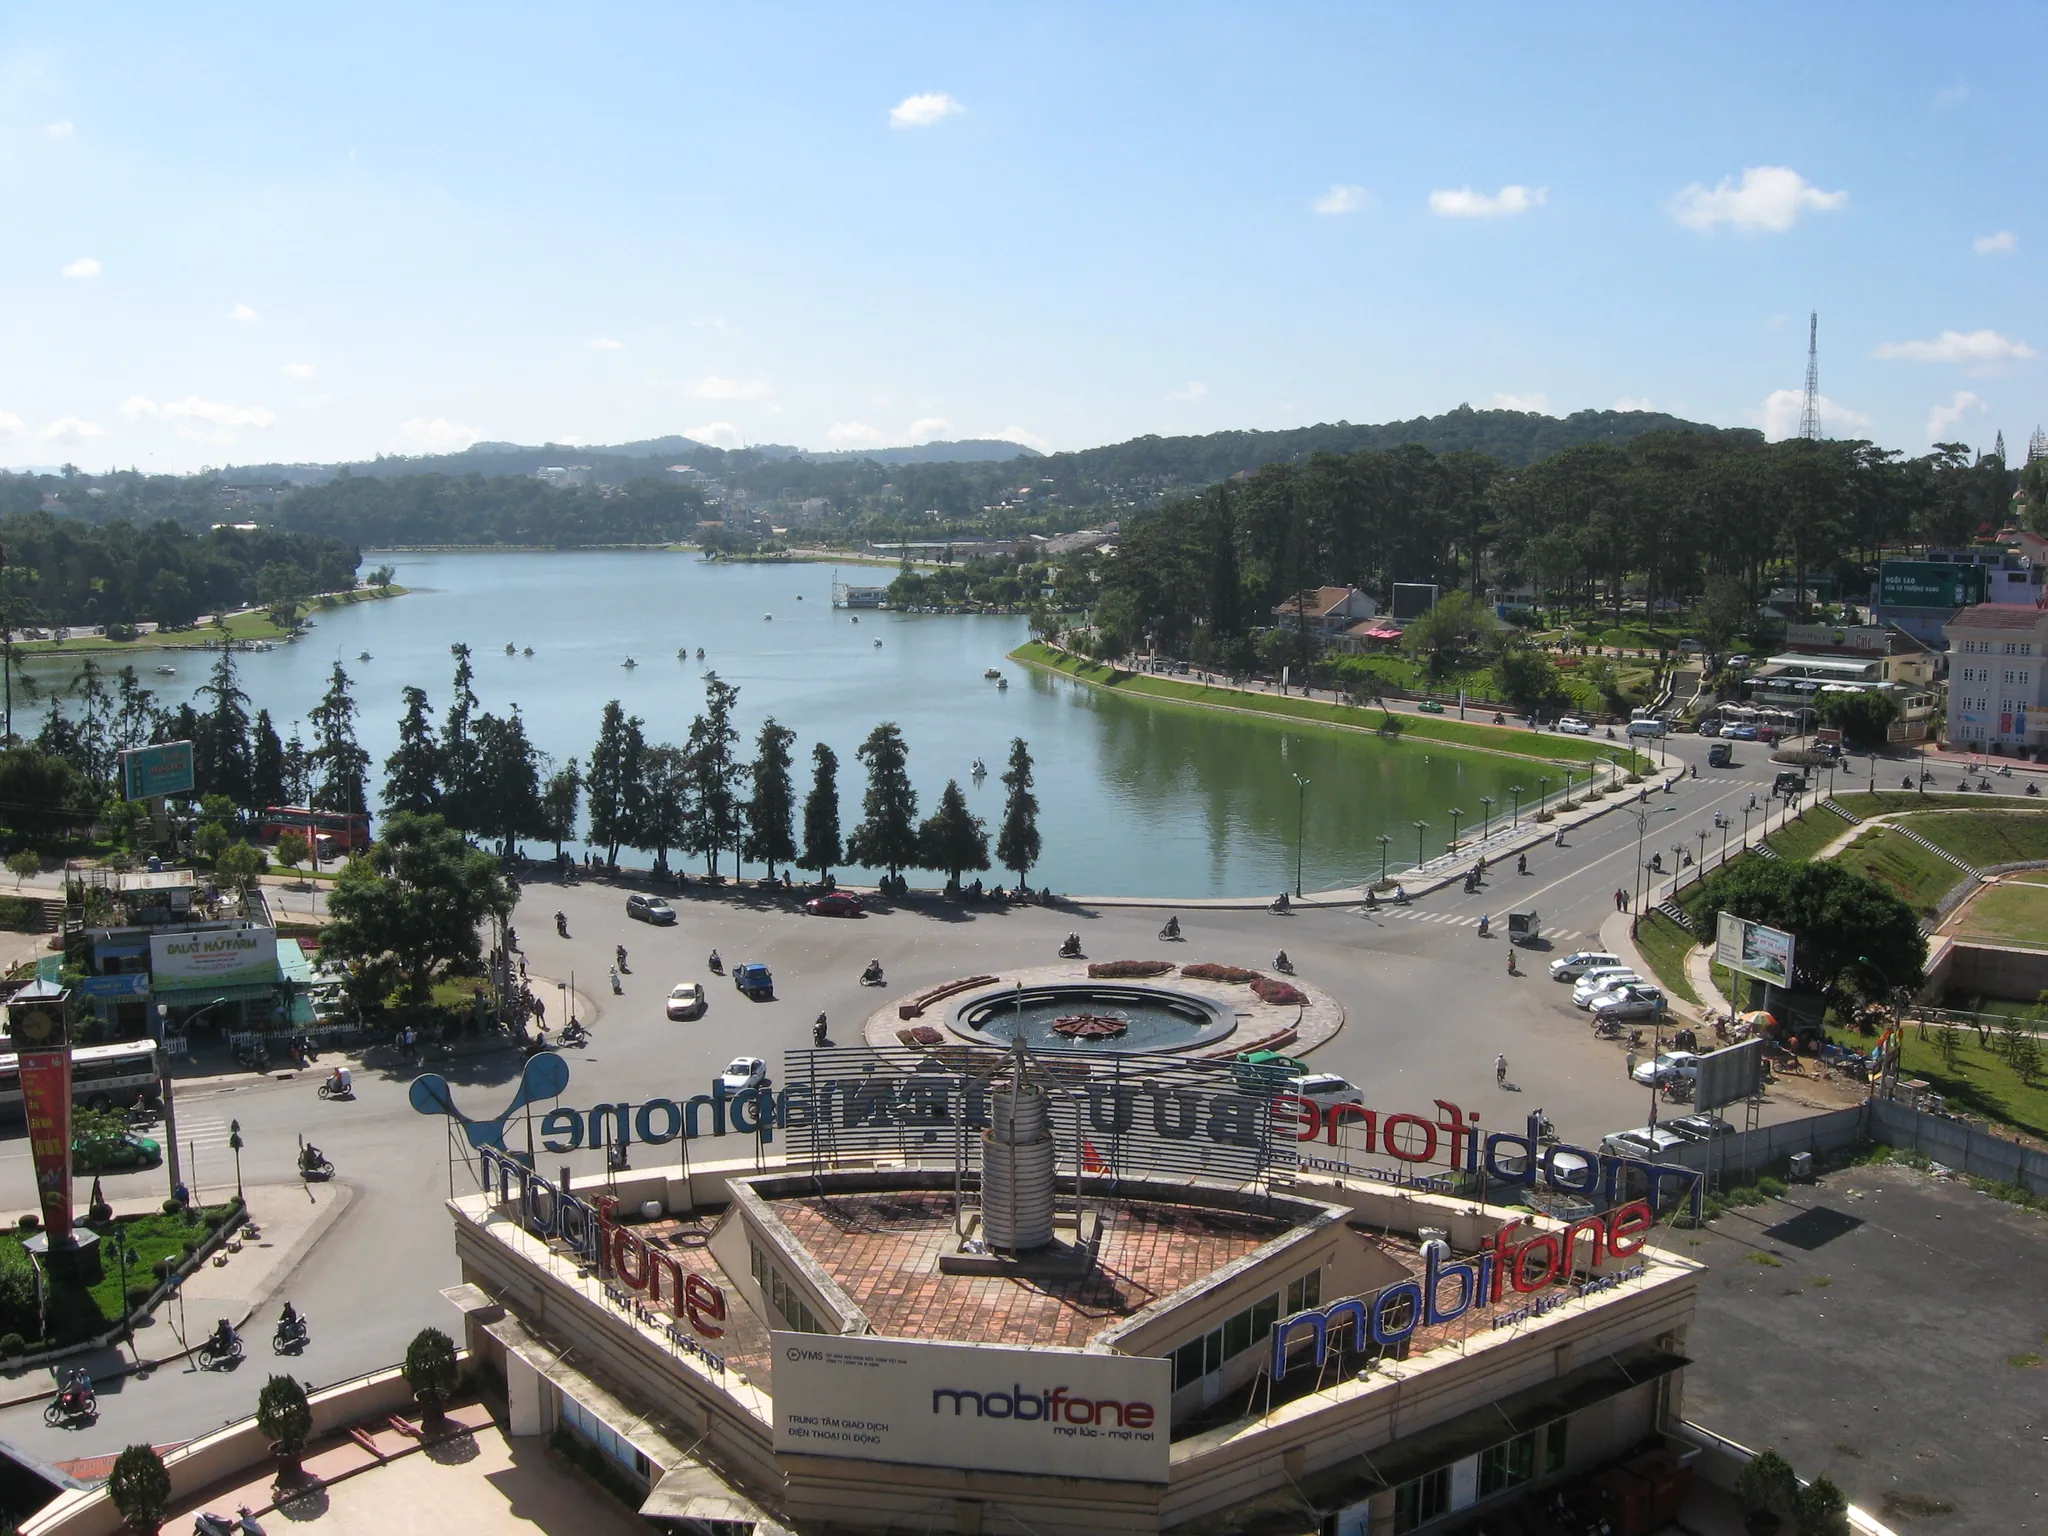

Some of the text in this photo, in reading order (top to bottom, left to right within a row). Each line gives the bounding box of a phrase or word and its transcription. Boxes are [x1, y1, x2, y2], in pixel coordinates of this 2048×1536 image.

[479, 1143, 726, 1339] mobifone
[1271, 1199, 1653, 1382] mobifone
[801, 1350, 823, 1360] VMS
[933, 1384, 1155, 1429] mobifone
[788, 1415, 889, 1432] TRUNG TÂM GIAO DỊCH
[812, 1430, 840, 1441] THOẠI
[842, 1433, 851, 1441] DI
